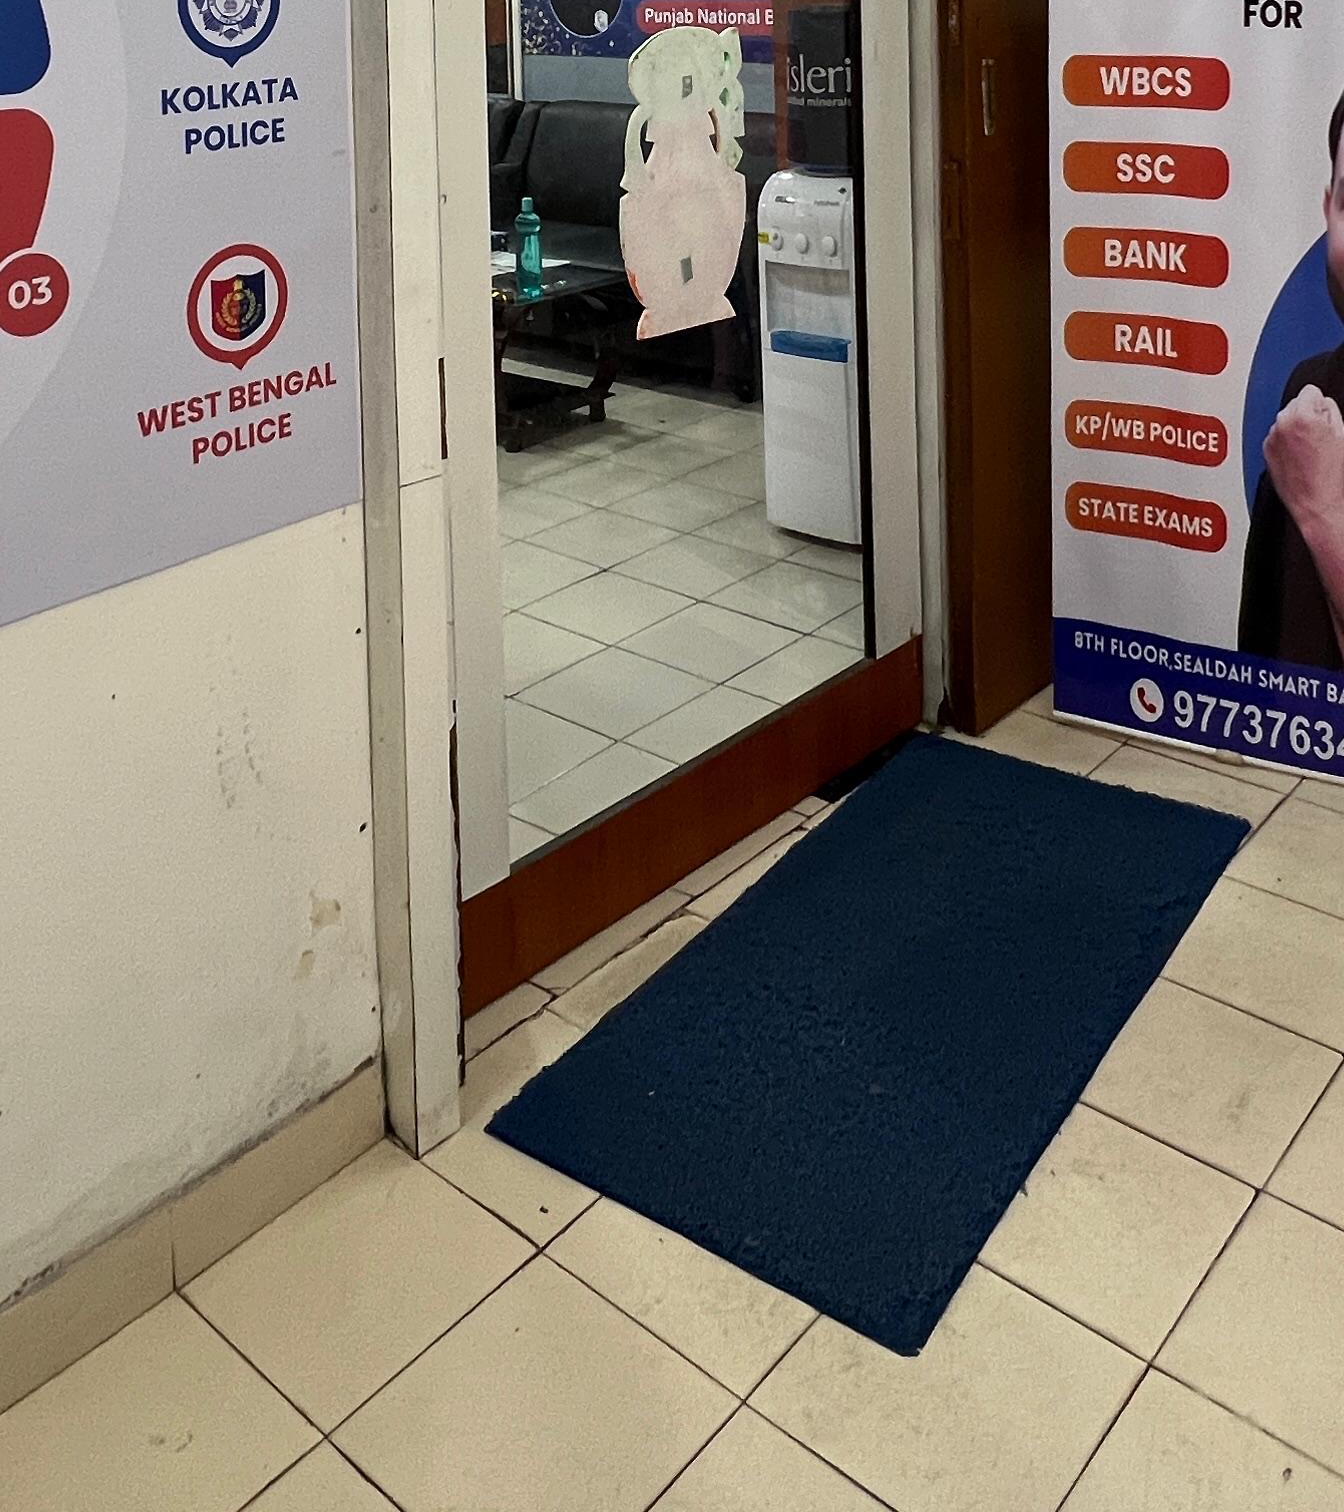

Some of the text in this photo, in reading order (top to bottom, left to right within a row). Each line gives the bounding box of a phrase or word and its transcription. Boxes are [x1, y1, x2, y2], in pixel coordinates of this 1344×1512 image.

[644, 6, 761, 27] Punjab National
[160, 76, 299, 116] KOLKATA
[1099, 65, 1193, 99] WBCS
[184, 117, 286, 155] POLICE
[1115, 153, 1176, 184] SSC
[1103, 239, 1188, 275] BANK
[7, 275, 53, 310] 03
[1113, 323, 1178, 359] RAIL
[137, 361, 338, 438] WEST BENGAL
[192, 412, 293, 465] POLICE
[1074, 412, 1220, 454] KP/WB POLICE
[1078, 497, 1214, 538] STATE EXAMS
[1073, 630, 1105, 654] 8TH
[1258, 668, 1321, 699] SMART
